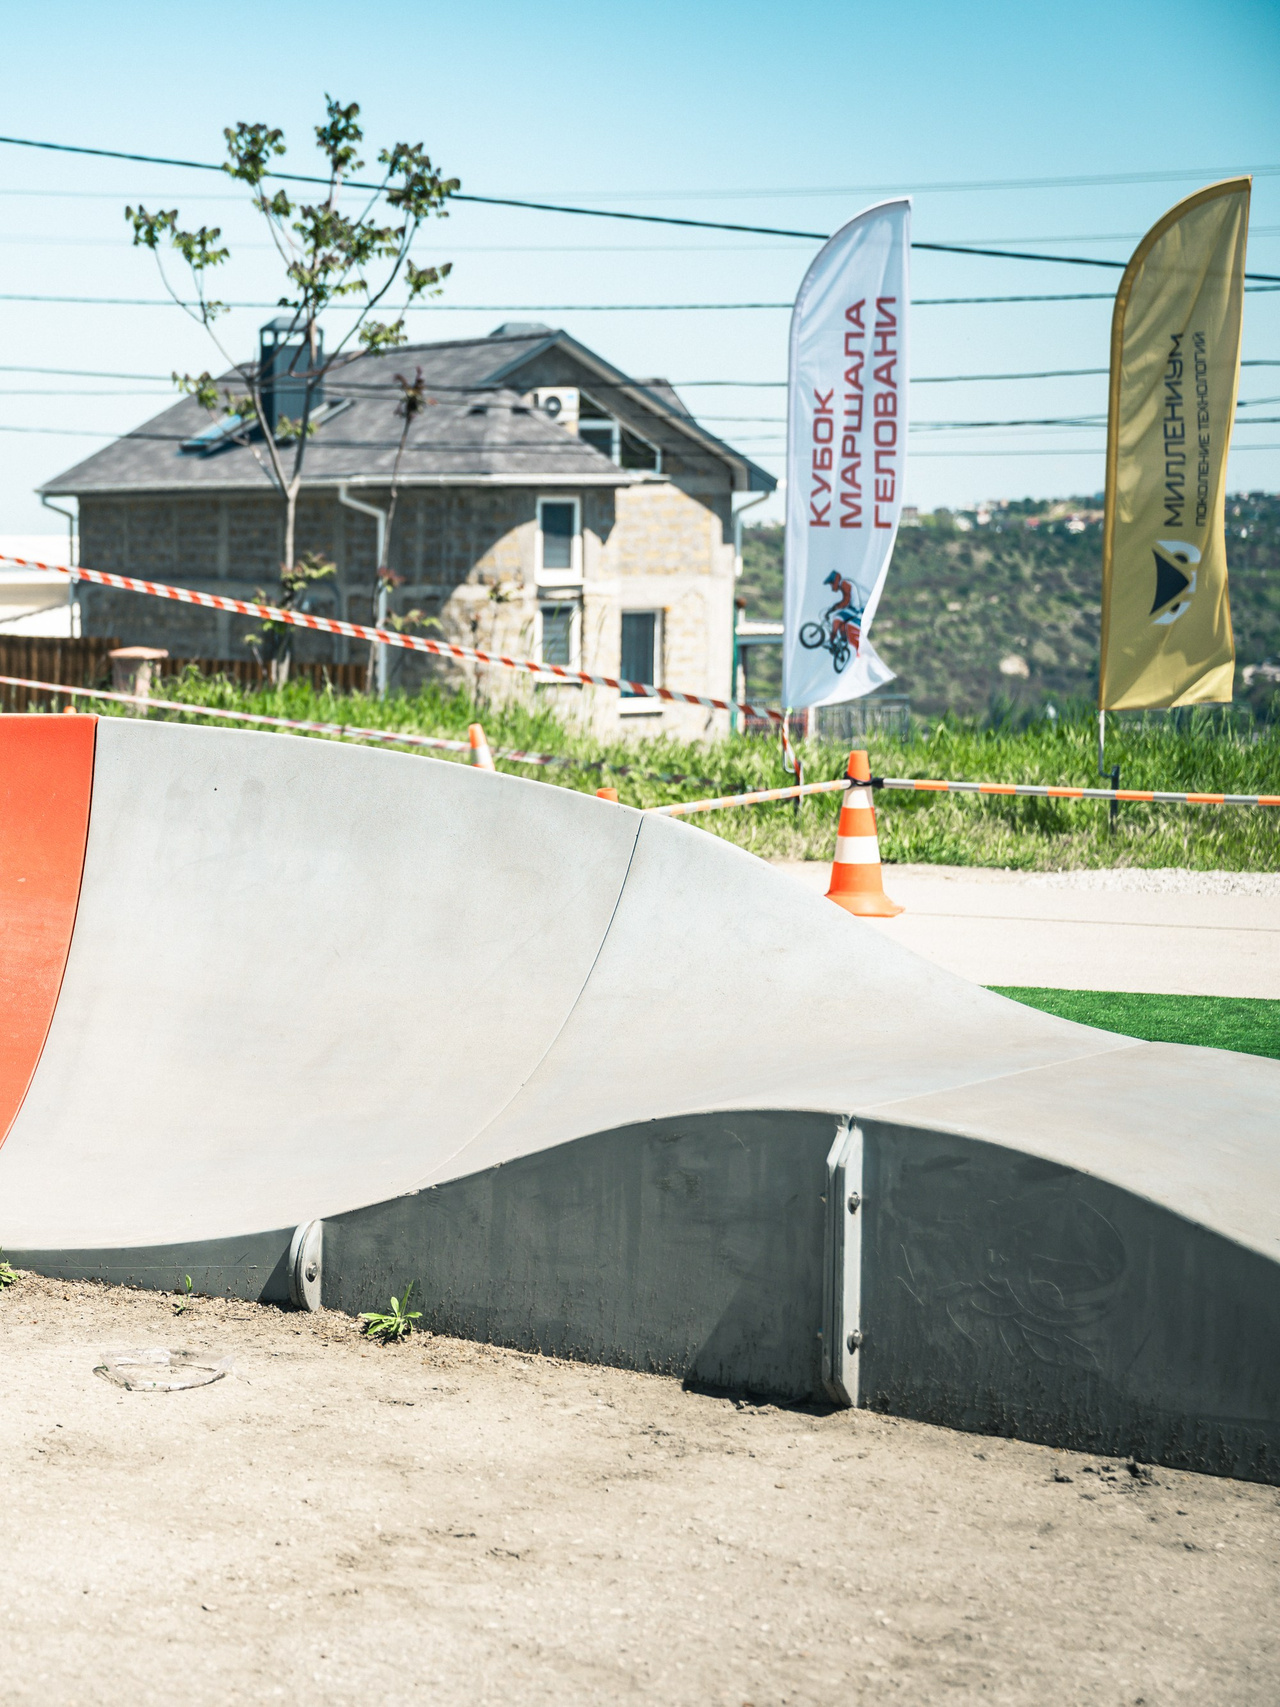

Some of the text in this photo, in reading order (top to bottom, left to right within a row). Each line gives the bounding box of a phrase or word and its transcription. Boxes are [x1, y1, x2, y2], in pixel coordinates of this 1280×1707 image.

[809, 387, 835, 528] КУБОК
[839, 298, 866, 529] МАРШАЛА
[873, 296, 898, 530] ГЕЛОВАНИ
[1163, 332, 1186, 528] МИЛЛЕНИУМ
[1192, 330, 1210, 528] ПОКОЛЕНИЕ ТЕХНОЛОГИЙ
